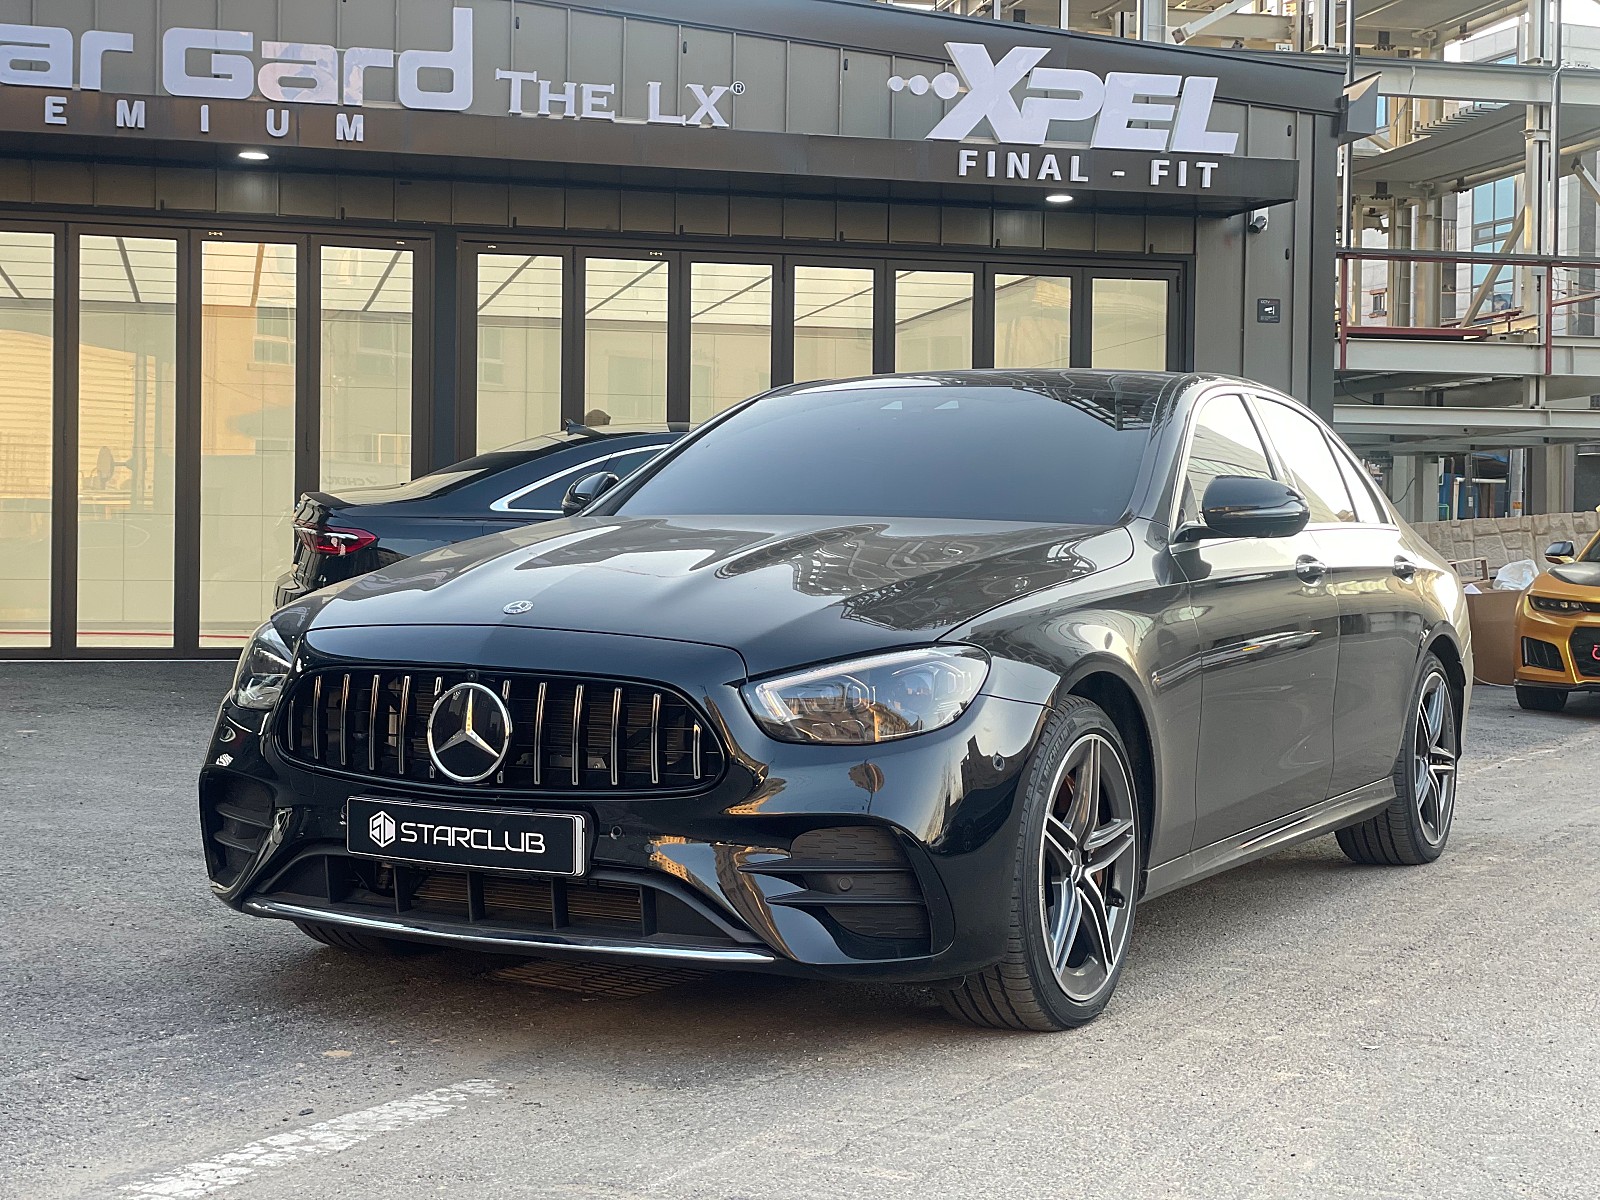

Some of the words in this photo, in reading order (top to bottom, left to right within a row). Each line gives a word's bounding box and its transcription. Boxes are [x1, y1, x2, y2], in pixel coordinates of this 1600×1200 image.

[162, 7, 474, 111] Gard
[495, 68, 615, 122] THE
[925, 42, 1240, 154] XPEL
[958, 150, 1089, 182] FINAL
[1150, 159, 1219, 188] FIT
[400, 821, 546, 854] STARCLUB
